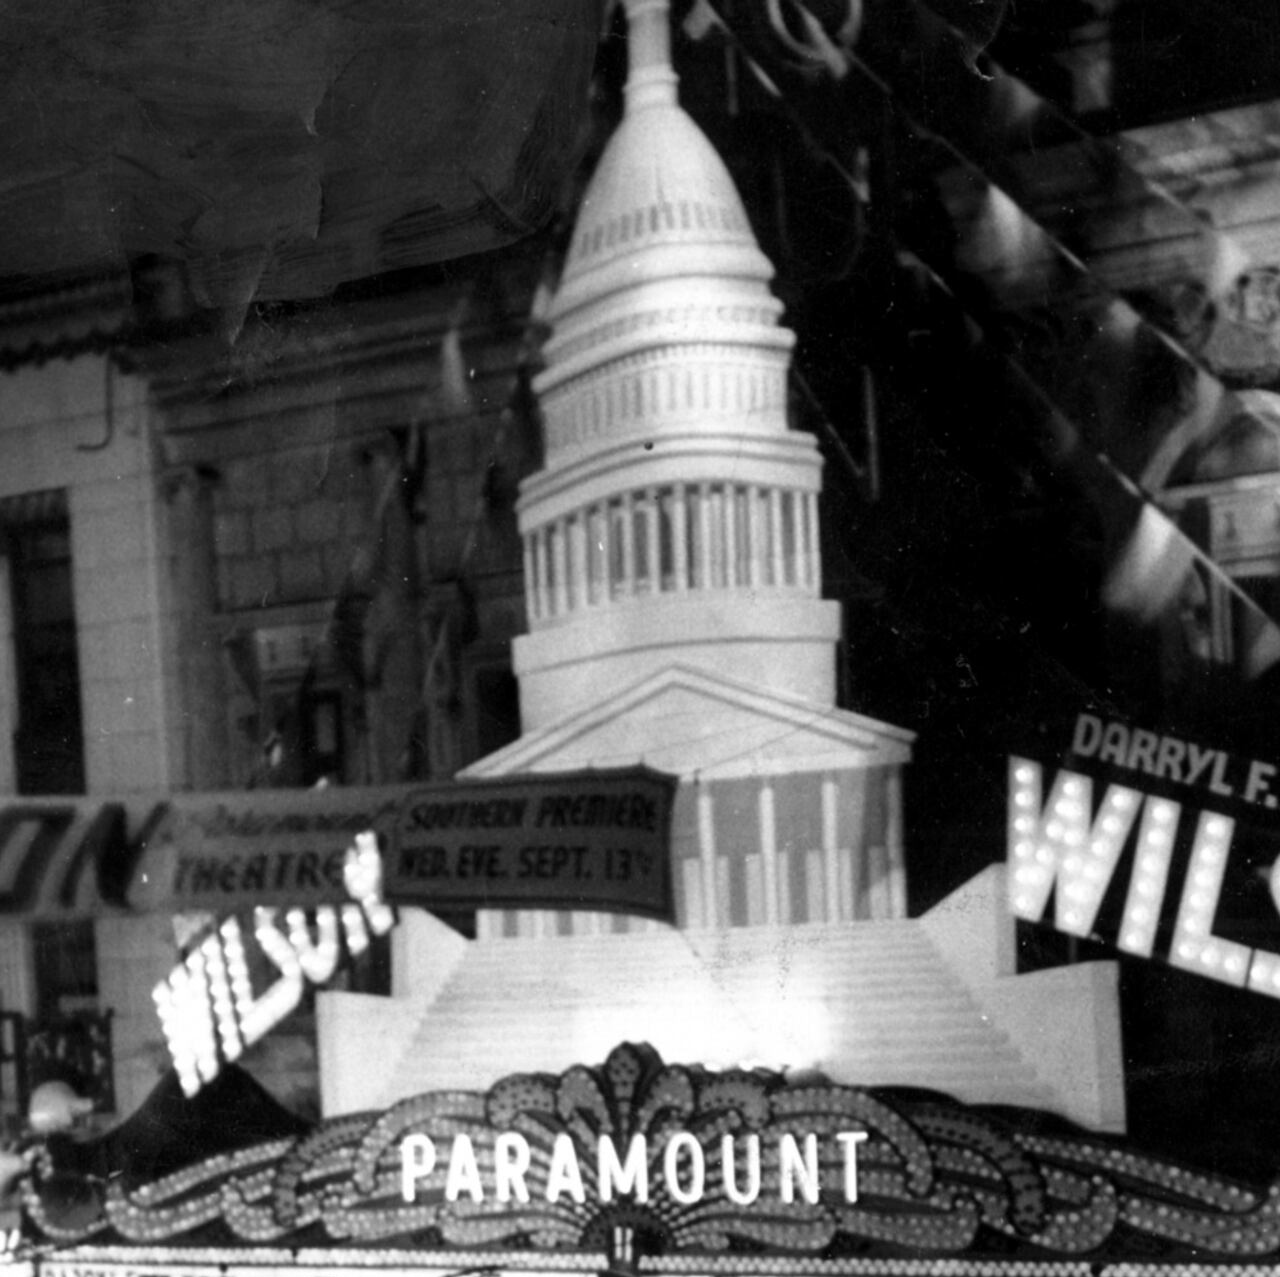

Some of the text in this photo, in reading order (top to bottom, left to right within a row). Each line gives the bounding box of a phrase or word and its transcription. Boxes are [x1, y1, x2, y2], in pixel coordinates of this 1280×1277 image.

[1073, 712, 1232, 796] DARRYL
[1243, 760, 1278, 811] F.
[173, 850, 347, 892] THEATRE
[516, 845, 594, 881] SEPT.
[399, 1132, 869, 1205] PARAMOUNT
